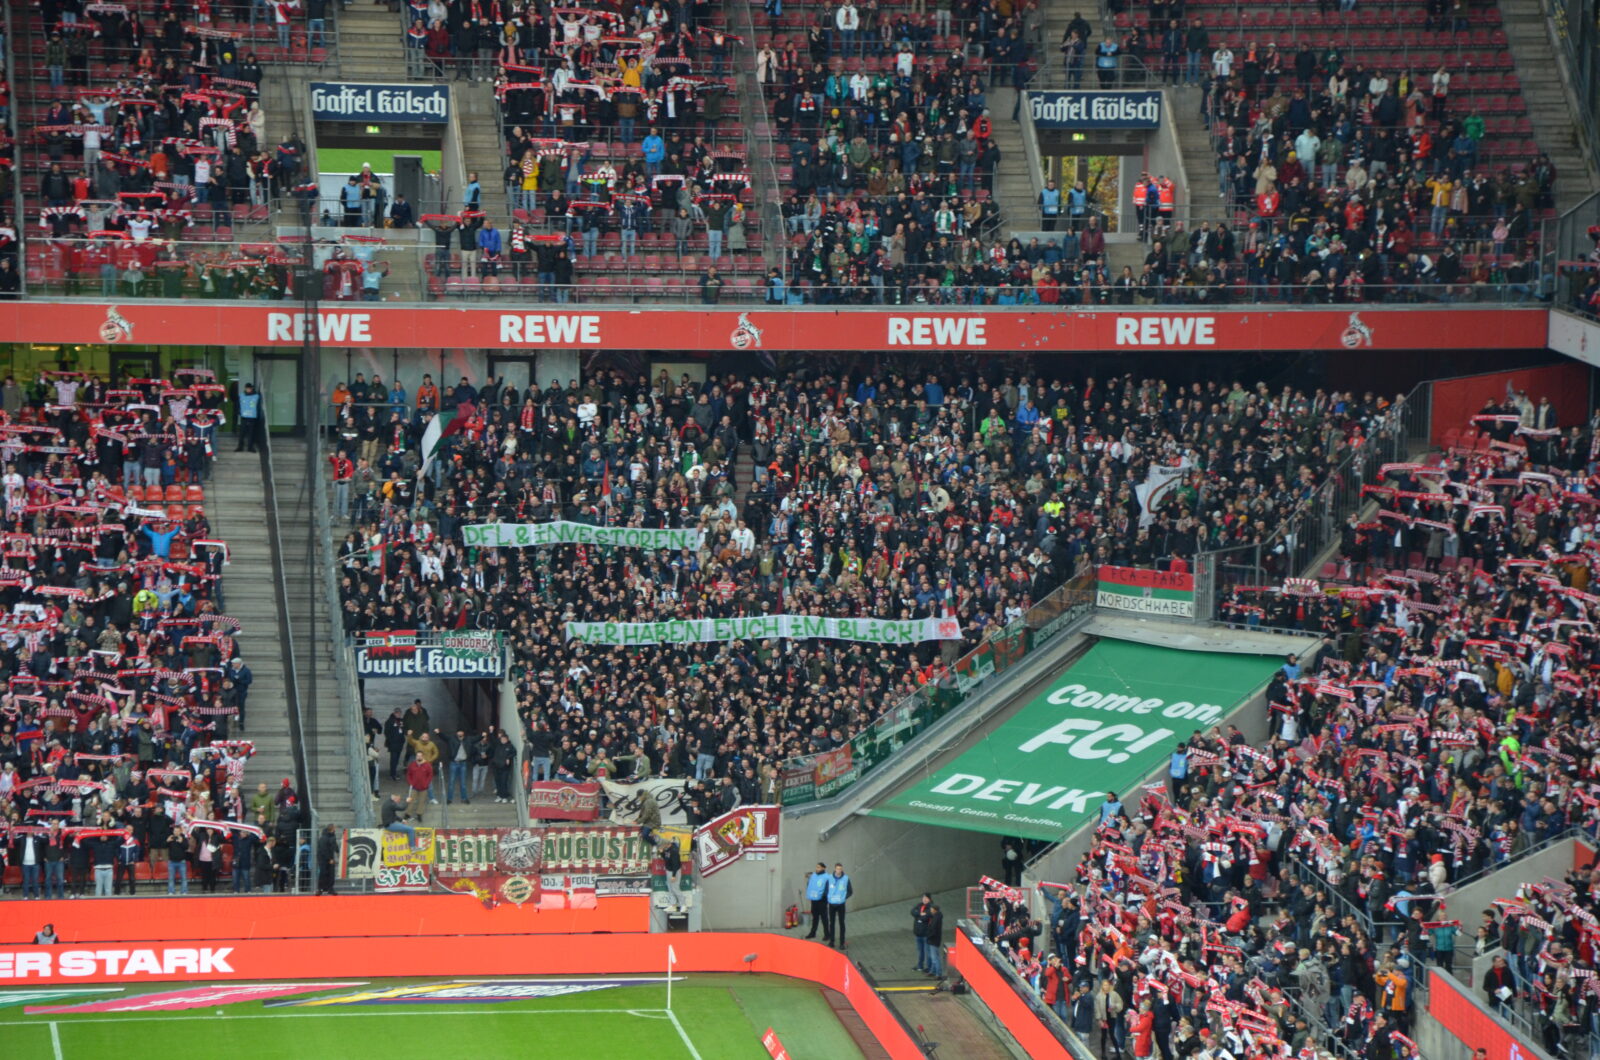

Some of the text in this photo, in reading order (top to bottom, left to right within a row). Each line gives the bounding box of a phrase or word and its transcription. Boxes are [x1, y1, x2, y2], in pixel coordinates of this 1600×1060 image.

[312, 86, 446, 117] Gaffel Kölsch
[1091, 96, 1158, 123] Kölsch
[268, 312, 372, 342] REWE
[500, 314, 601, 343] REWE
[888, 317, 987, 345] REWE
[1116, 317, 1215, 345] REWE
[464, 525, 510, 545] DFL
[515, 526, 529, 544] &
[1152, 571, 1185, 587] FANS
[1100, 593, 1193, 616] NORDSCHWABEN
[623, 619, 701, 643] HABEN
[714, 617, 779, 640] EUCH
[1047, 684, 1164, 715] Come
[1018, 718, 1175, 764] FC!
[930, 773, 1109, 814] DEVK
[908, 800, 954, 814] Gesagt.
[1003, 813, 1063, 829] Geholfen.
[435, 839, 497, 864] LEGIO
[543, 837, 650, 862] AUGUSTA
[59, 947, 235, 977] STARK
